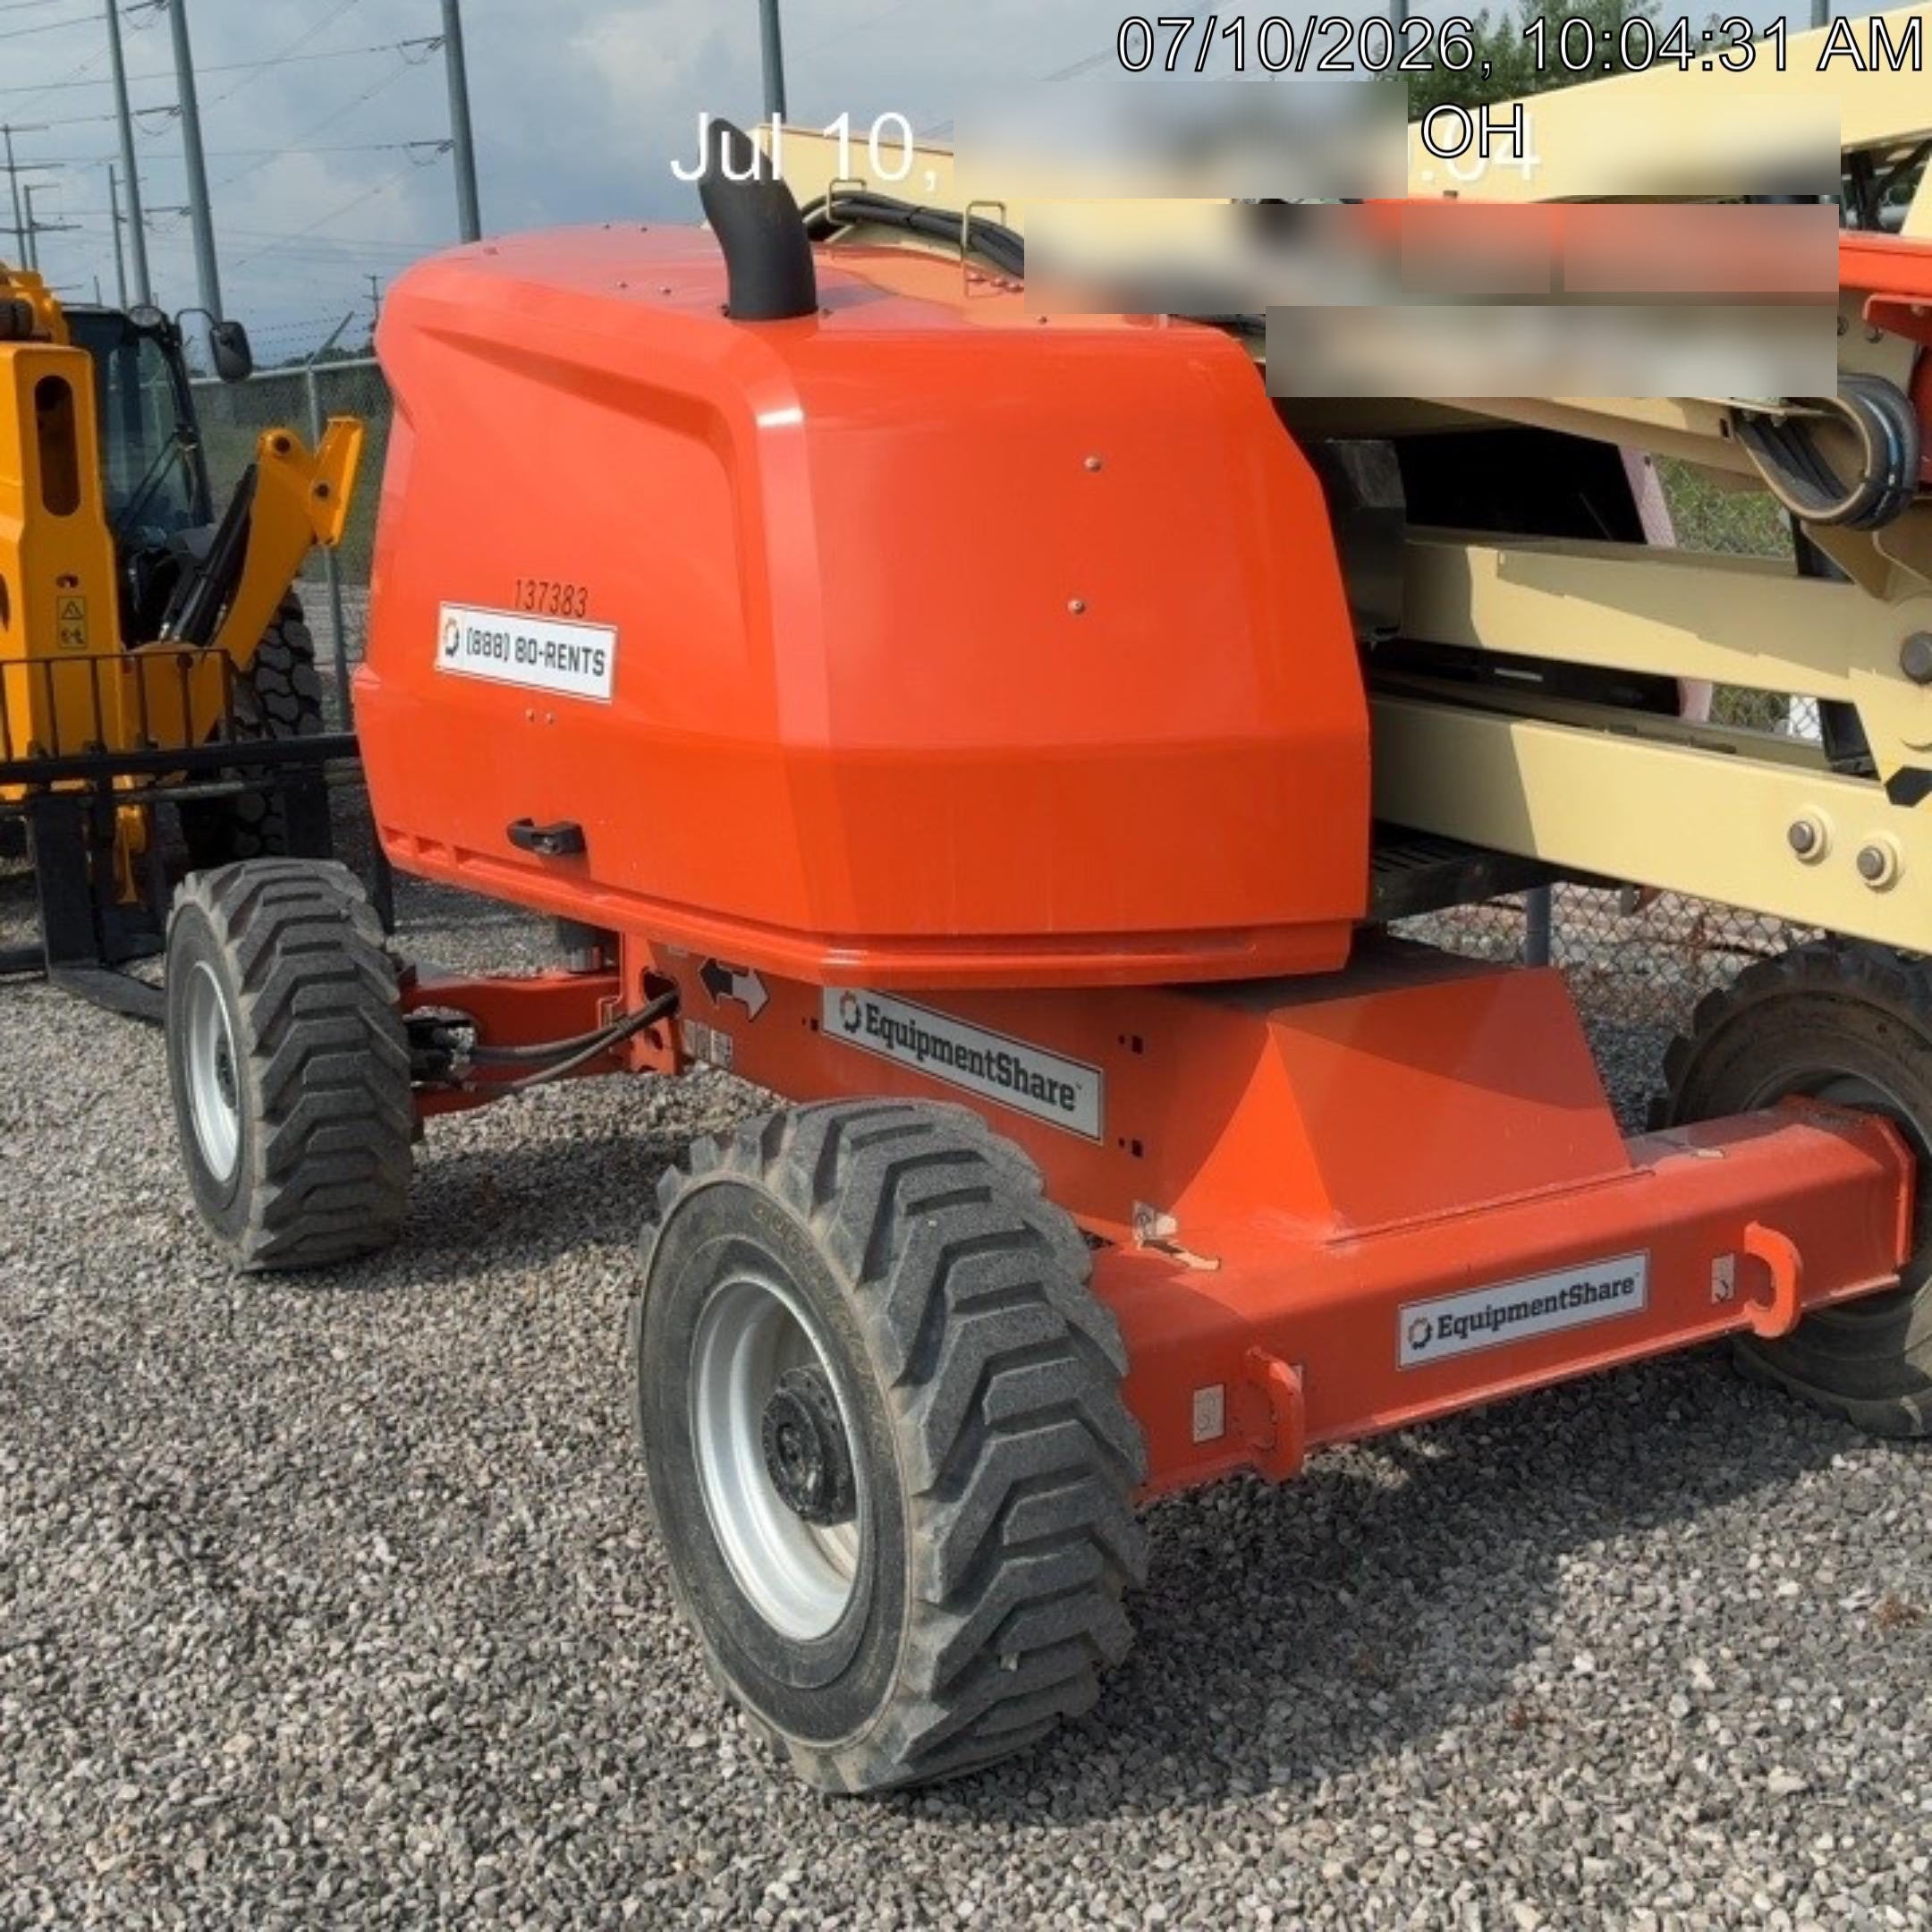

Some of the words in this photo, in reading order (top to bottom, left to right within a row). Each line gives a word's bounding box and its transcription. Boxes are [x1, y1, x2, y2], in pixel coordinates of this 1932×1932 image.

[514, 579, 589, 618] 137383
[466, 627, 510, 662] (888)
[514, 636, 606, 676] 80-RENTS
[865, 1002, 1076, 1112] EquipmentShare
[1436, 1276, 1635, 1340] EquipmentShare
